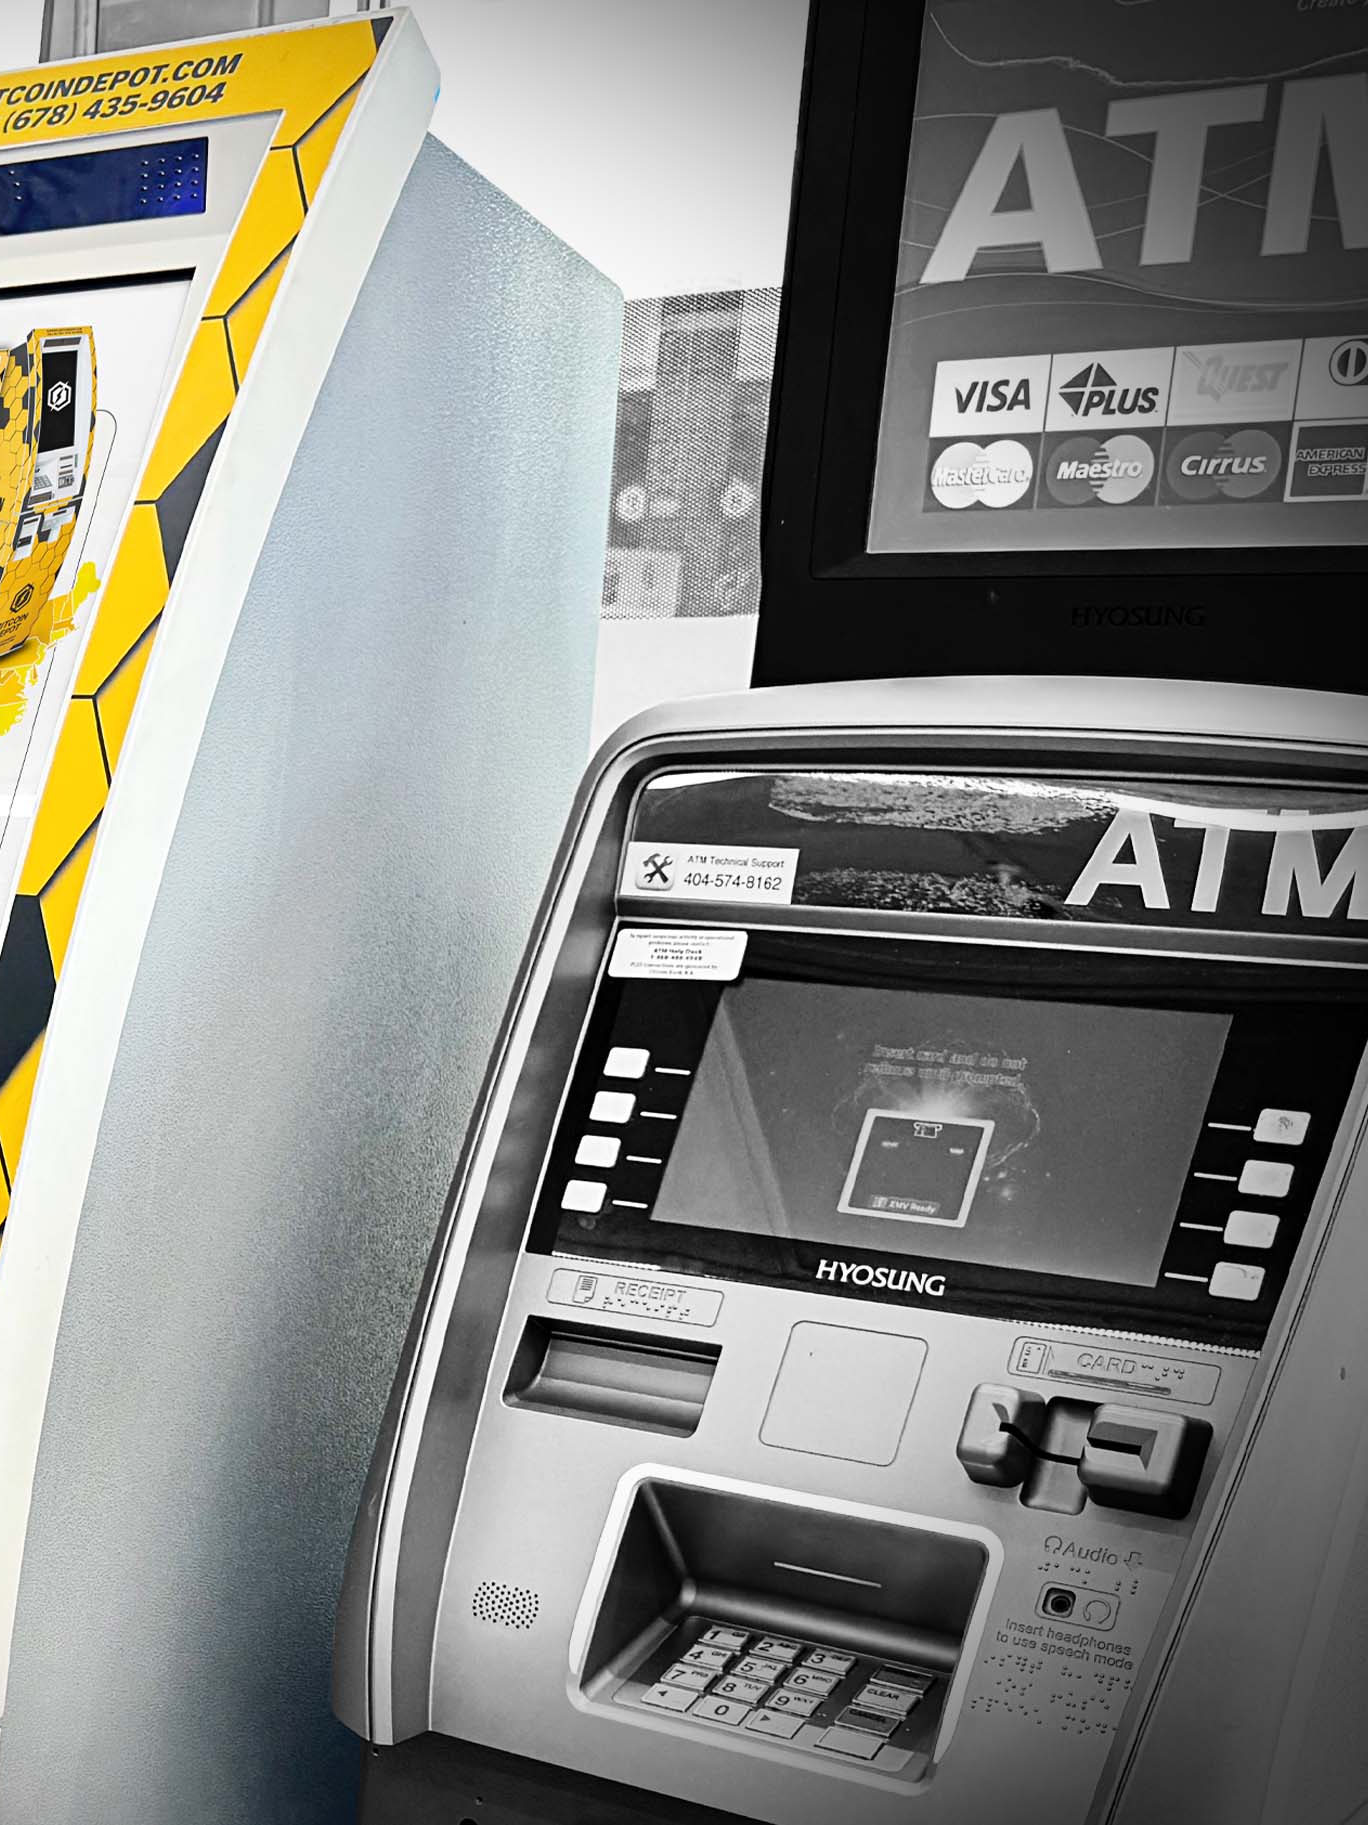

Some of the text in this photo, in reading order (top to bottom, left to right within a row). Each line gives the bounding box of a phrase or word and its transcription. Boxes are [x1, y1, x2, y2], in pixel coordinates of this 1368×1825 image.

[2, 103, 78, 140] (678)
[81, 81, 226, 122] 435-9604
[918, 72, 1368, 284] ATM
[953, 378, 1032, 415] VISA
[1082, 387, 1158, 417] PLUS
[1296, 447, 1365, 460] AMERICAN
[1056, 456, 1144, 482] Maestro
[1181, 452, 1265, 477] Cirrus
[1308, 463, 1367, 476] EXPRESS
[1070, 605, 1206, 628] HYOSUNG
[688, 856, 784, 868] ATM Technical Support
[1064, 809, 1368, 921] ATM
[684, 873, 782, 890] 404-574-8162
[815, 1259, 947, 1297] HYOSUNG
[614, 1281, 687, 1303] RECEIPT
[1077, 1353, 1137, 1374] CARD
[1062, 1542, 1118, 1565] Audio
[710, 1630, 721, 1639] 1
[1006, 1618, 1132, 1656] Insert headphones
[690, 1650, 704, 1659] 4
[758, 1642, 773, 1652] 2
[996, 1631, 1134, 1670] to use speech mode
[741, 1662, 756, 1672] 5
[811, 1654, 825, 1664] 3
[671, 1669, 686, 1679] 7
[793, 1674, 809, 1685] 6
[722, 1682, 737, 1693] 8
[867, 1688, 900, 1700] CLEAR
[775, 1696, 790, 1705] 9
[714, 1704, 730, 1716] 0
